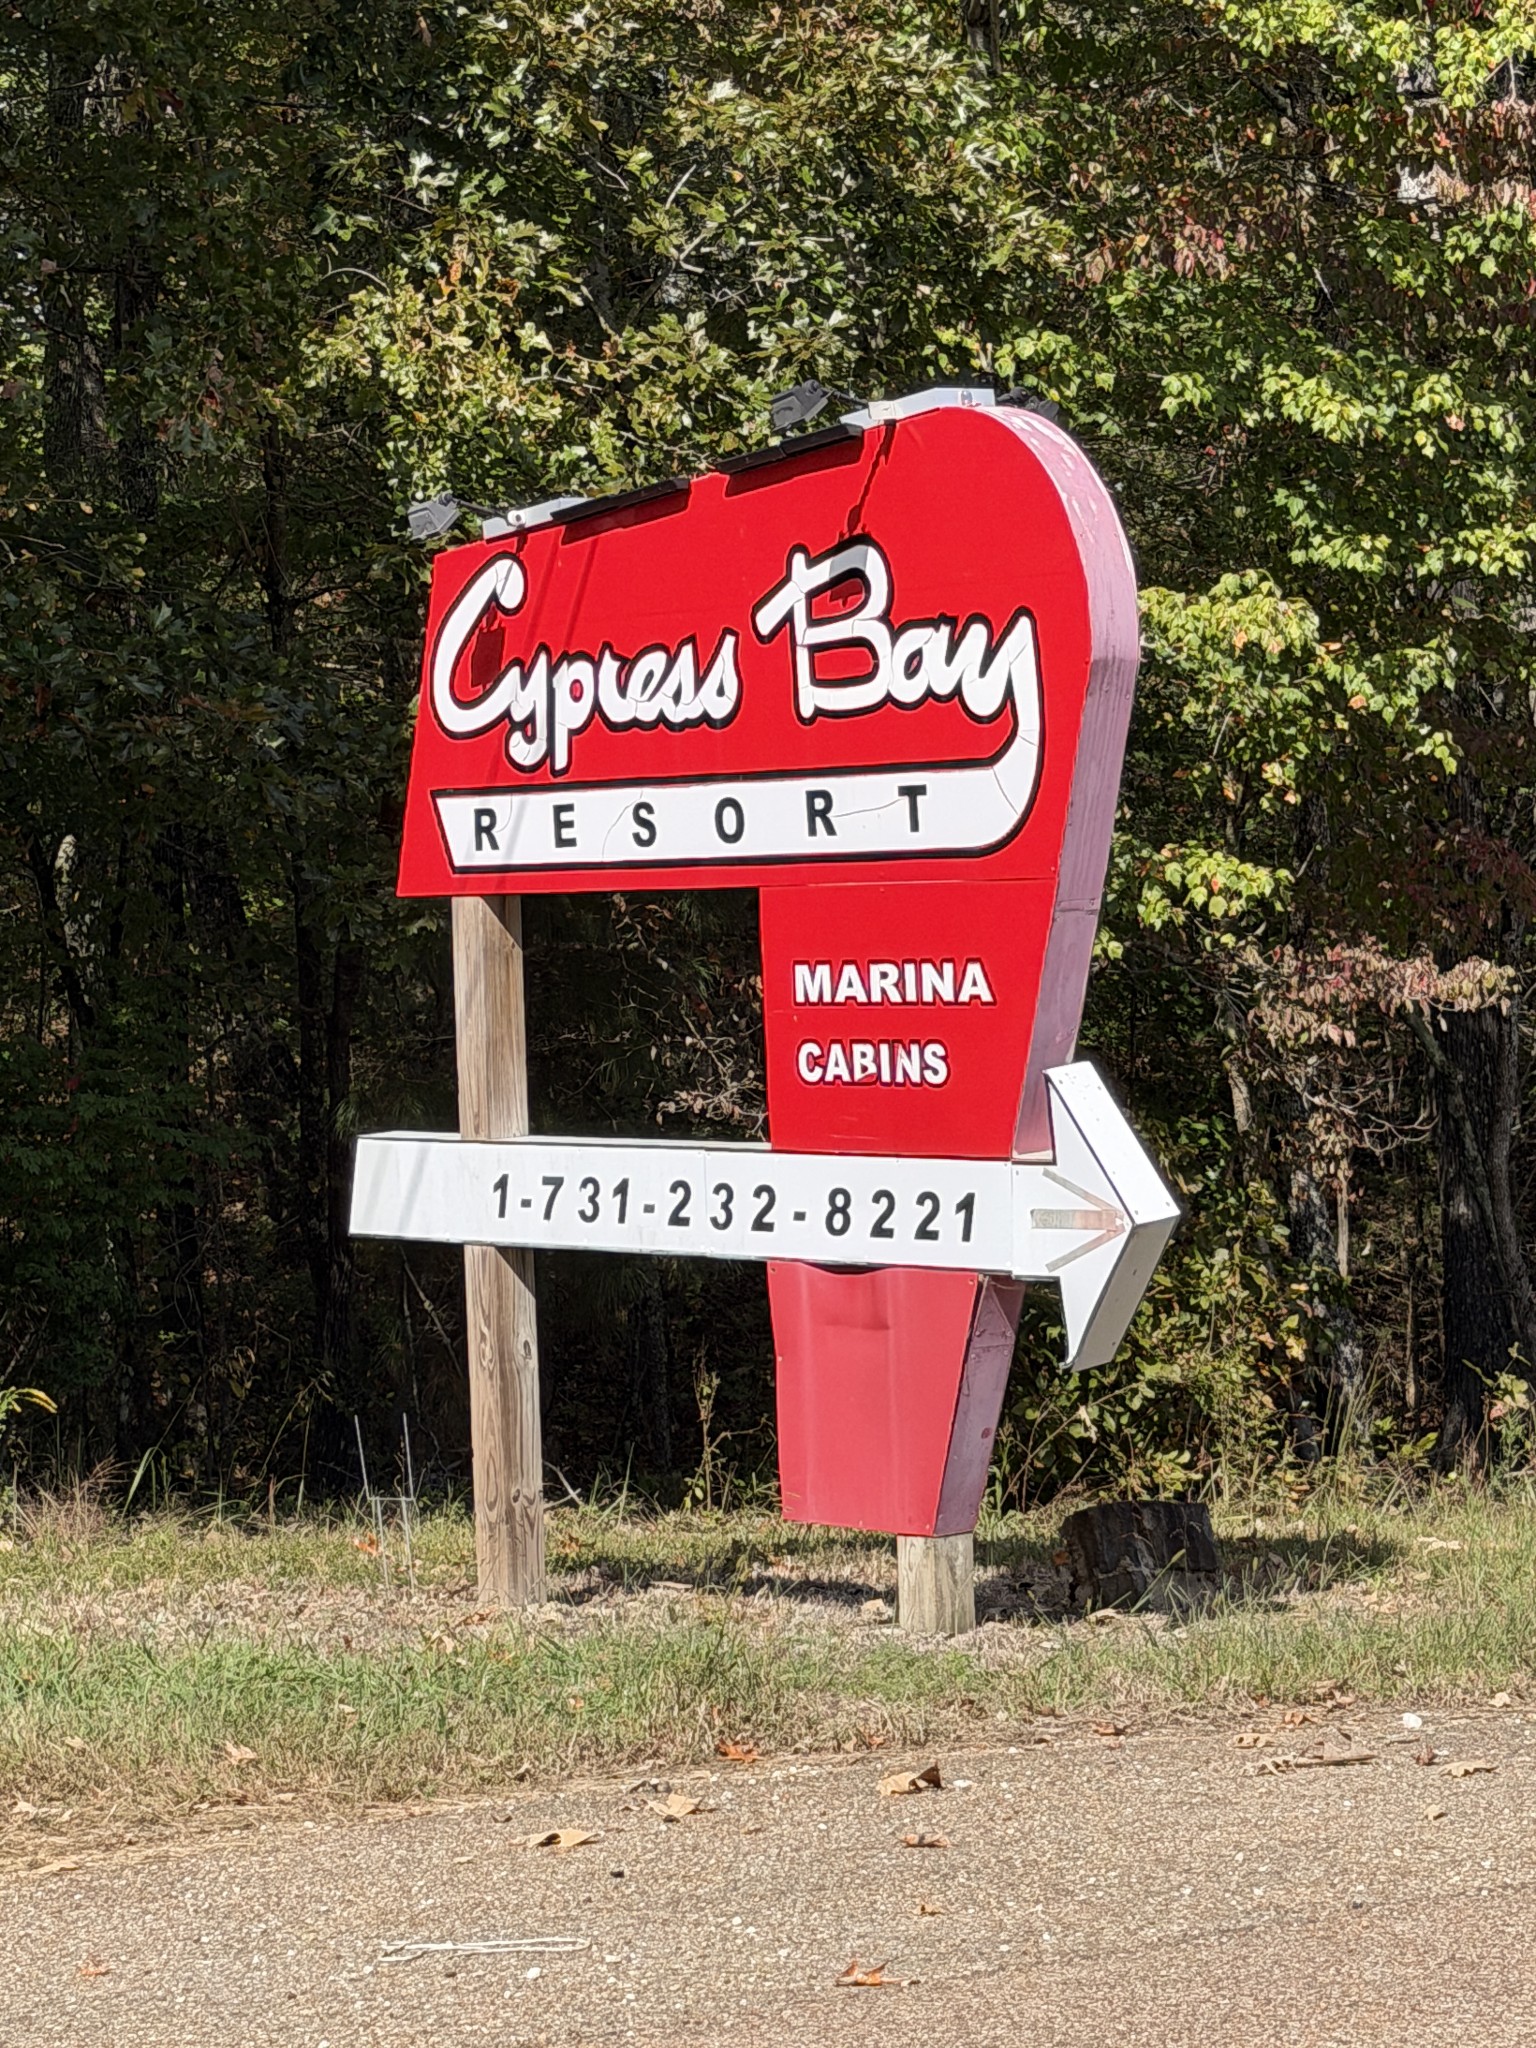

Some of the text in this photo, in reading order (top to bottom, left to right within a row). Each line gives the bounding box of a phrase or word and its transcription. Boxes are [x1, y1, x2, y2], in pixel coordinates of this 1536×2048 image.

[430, 535, 1043, 776] Cypress Bay
[474, 785, 928, 852] RESORT
[793, 959, 995, 1006] MARINA
[797, 1040, 950, 1087] CABINS
[492, 1172, 977, 1243] 1-731-232-8221
